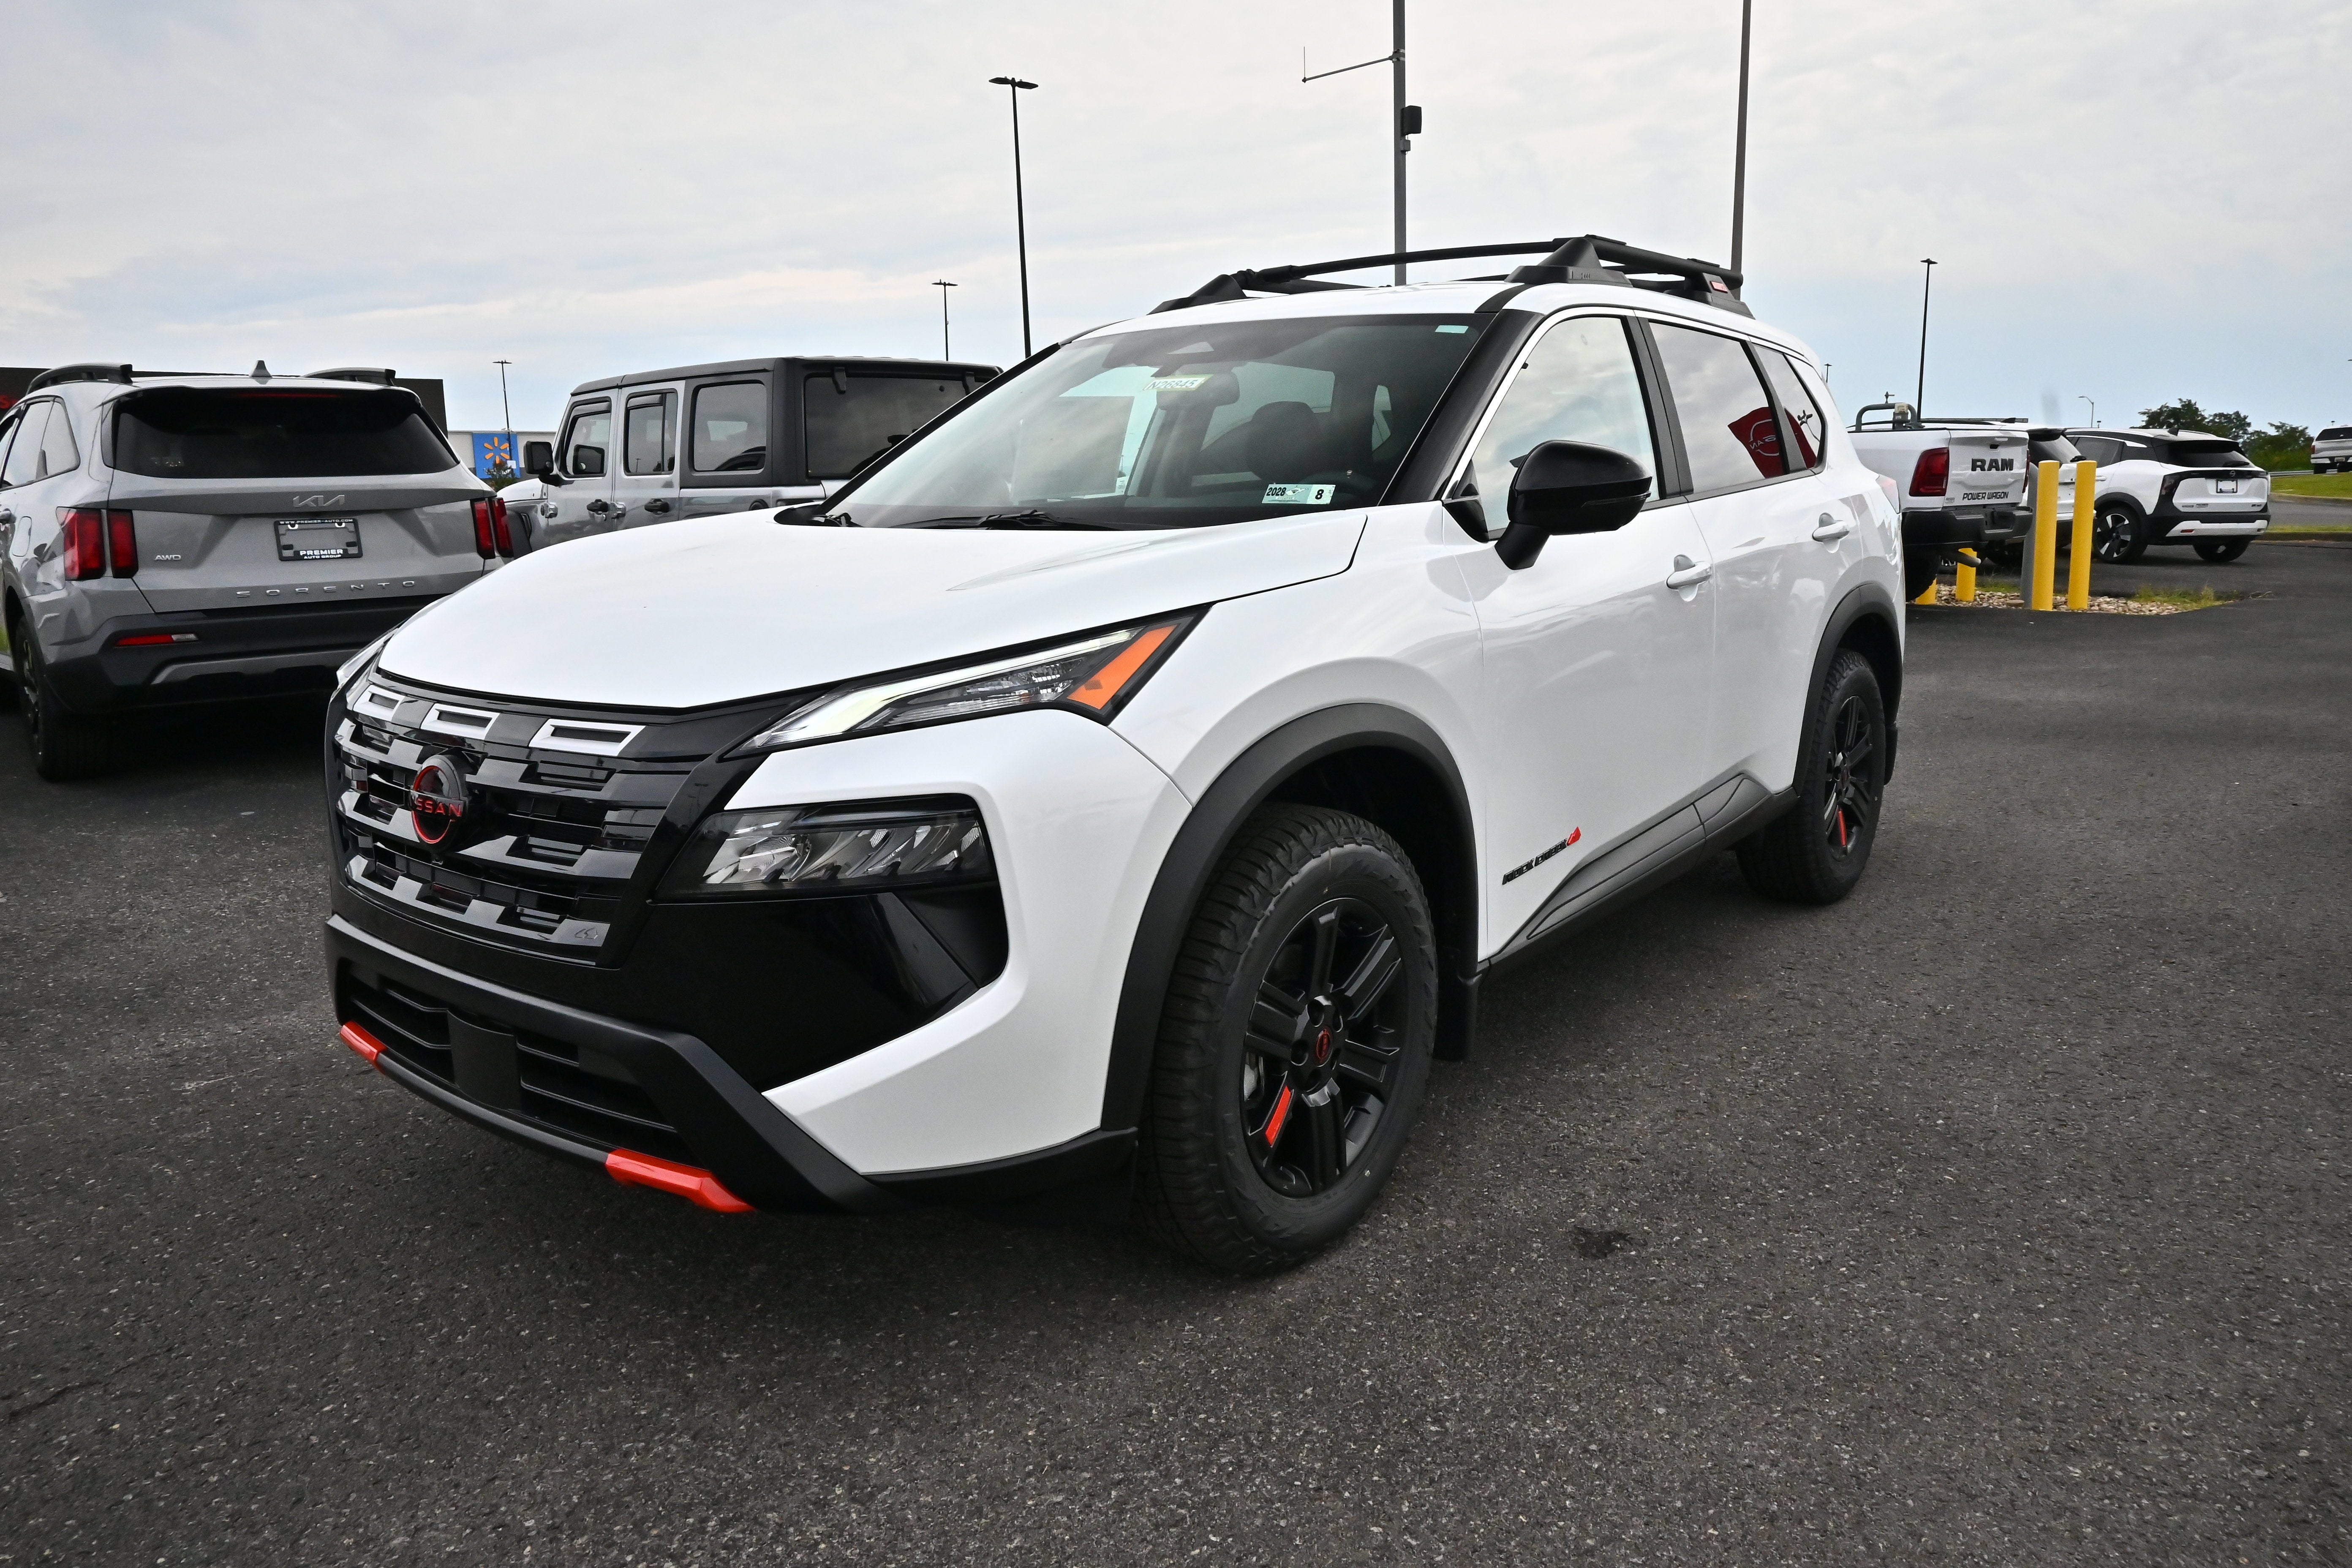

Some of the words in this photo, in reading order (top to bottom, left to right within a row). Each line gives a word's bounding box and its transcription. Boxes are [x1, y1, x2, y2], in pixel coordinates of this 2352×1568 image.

[1147, 380, 1198, 389] N26845
[1971, 458, 2014, 471] RAM
[1266, 487, 1287, 496] 2028
[1315, 489, 1324, 500] 8
[1963, 492, 1986, 501] POWER
[1987, 492, 2009, 500] WAGON
[293, 495, 345, 507] KIA
[237, 580, 415, 597] SORENTO
[411, 792, 462, 817] SSAN
